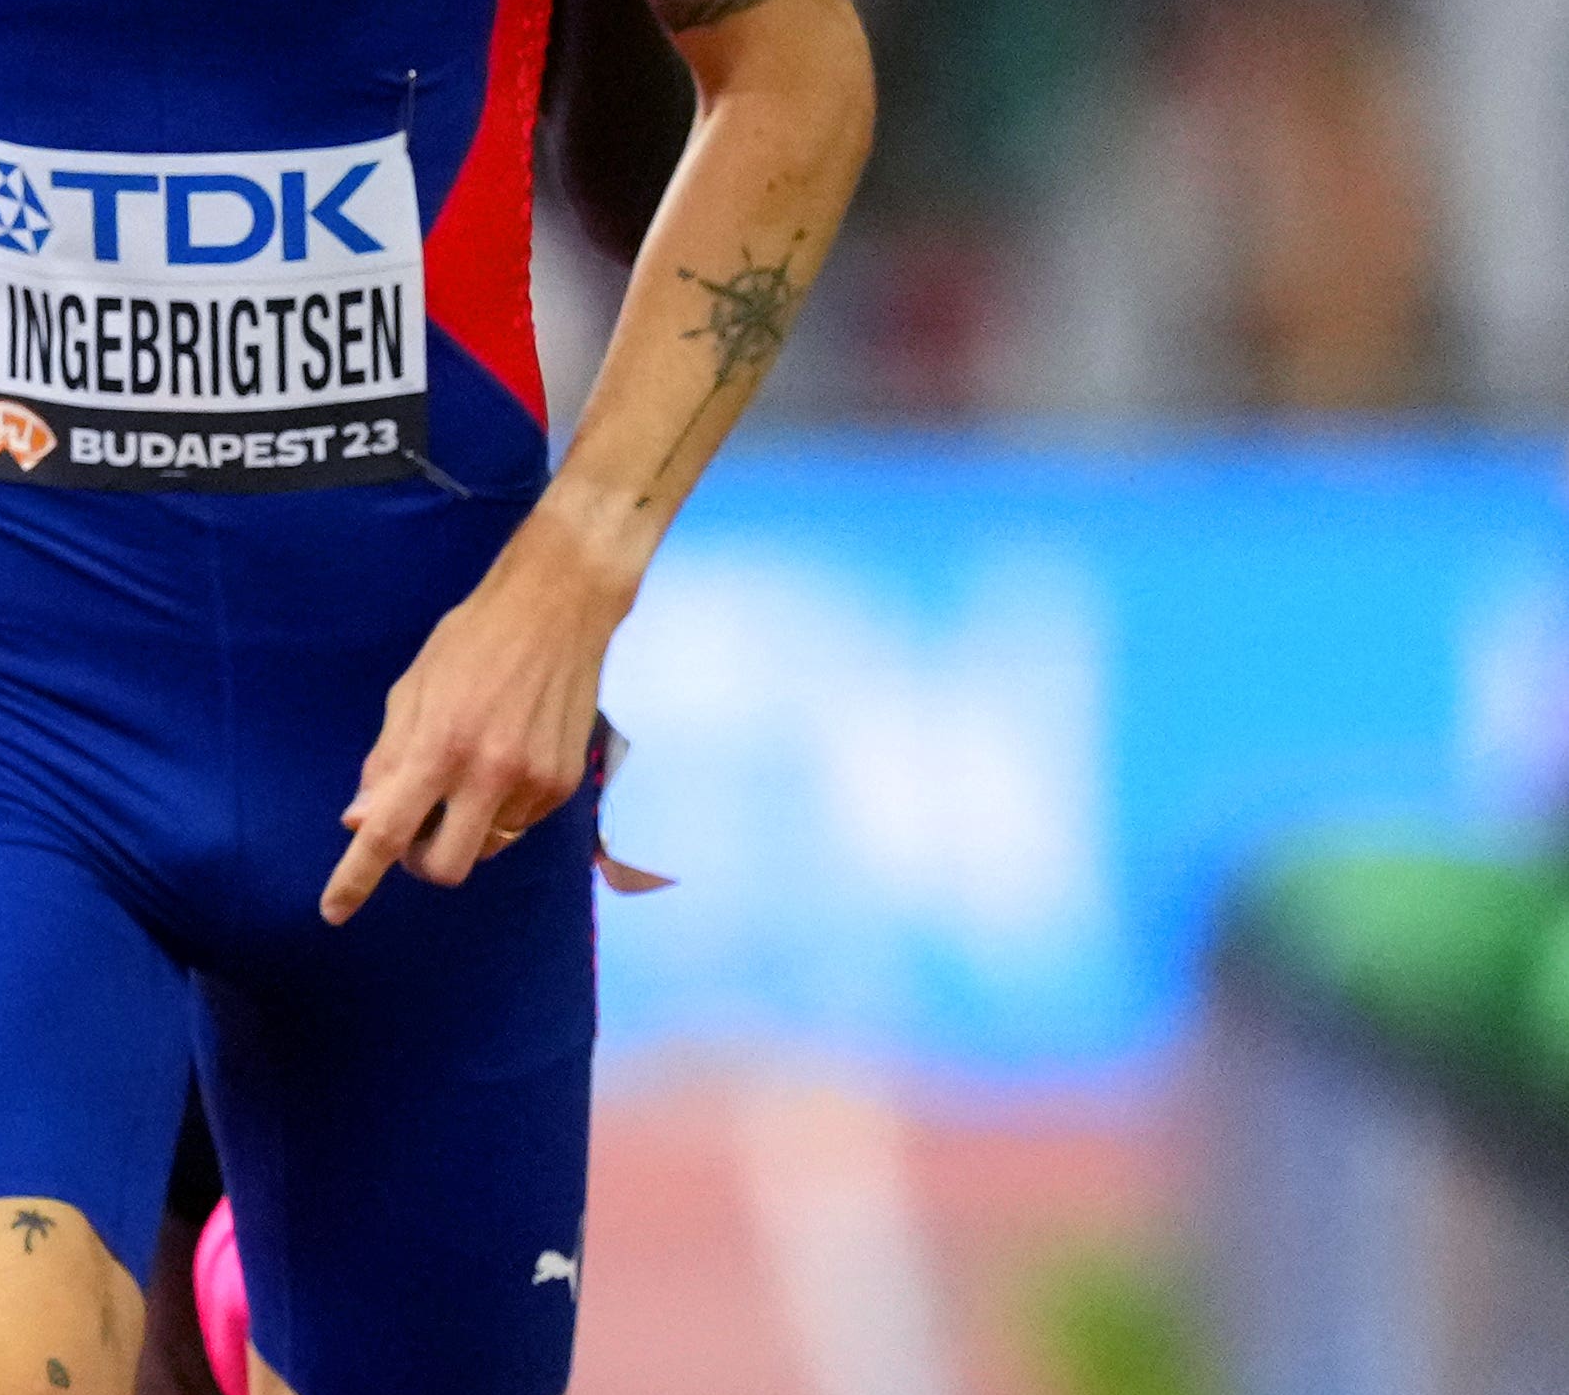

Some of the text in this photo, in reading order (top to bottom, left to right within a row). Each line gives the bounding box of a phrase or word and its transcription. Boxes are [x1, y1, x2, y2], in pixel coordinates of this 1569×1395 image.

[50, 161, 387, 266] TDK
[8, 284, 404, 397] INGEBRIGTSEN
[69, 419, 399, 470] BUDAPEST 23
